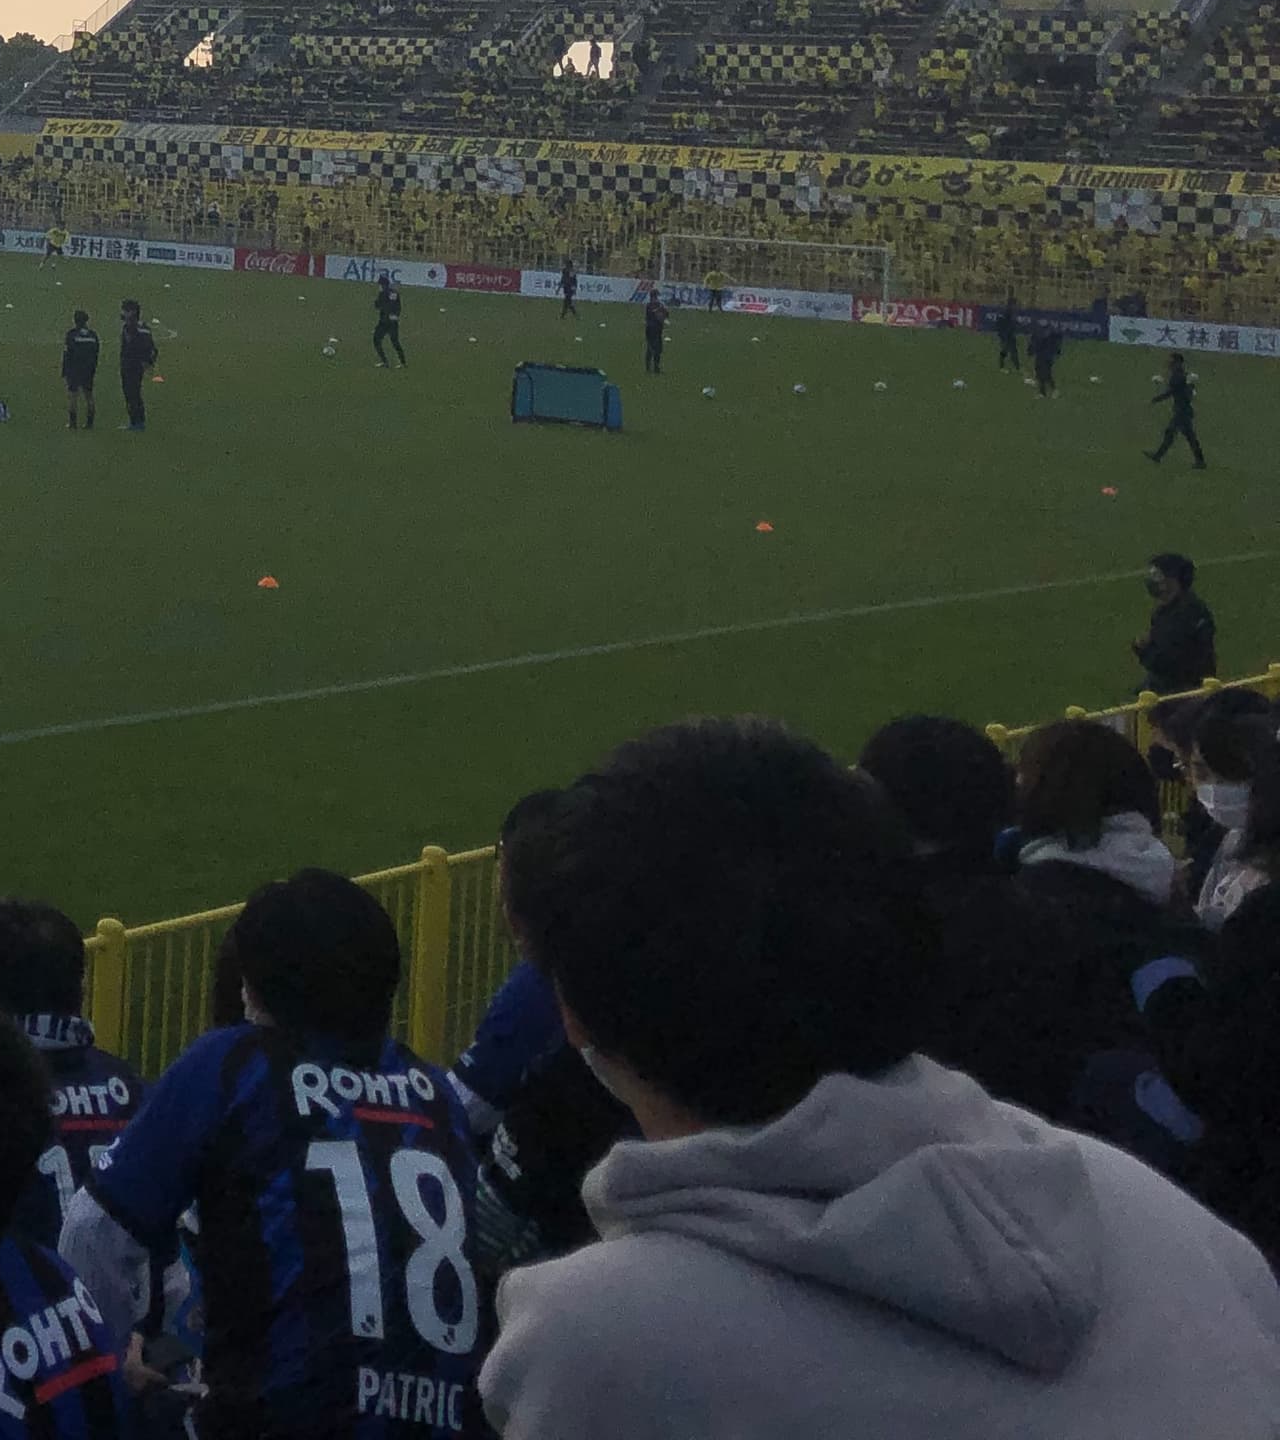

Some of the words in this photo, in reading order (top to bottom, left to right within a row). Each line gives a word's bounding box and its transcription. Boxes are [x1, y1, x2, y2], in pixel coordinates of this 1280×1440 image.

[856, 300, 974, 328] HITACHI
[49, 1076, 131, 1117] OHTO
[293, 1062, 436, 1120] ROHTO
[304, 1139, 480, 1356] 18
[357, 1366, 464, 1432] PATRIC
